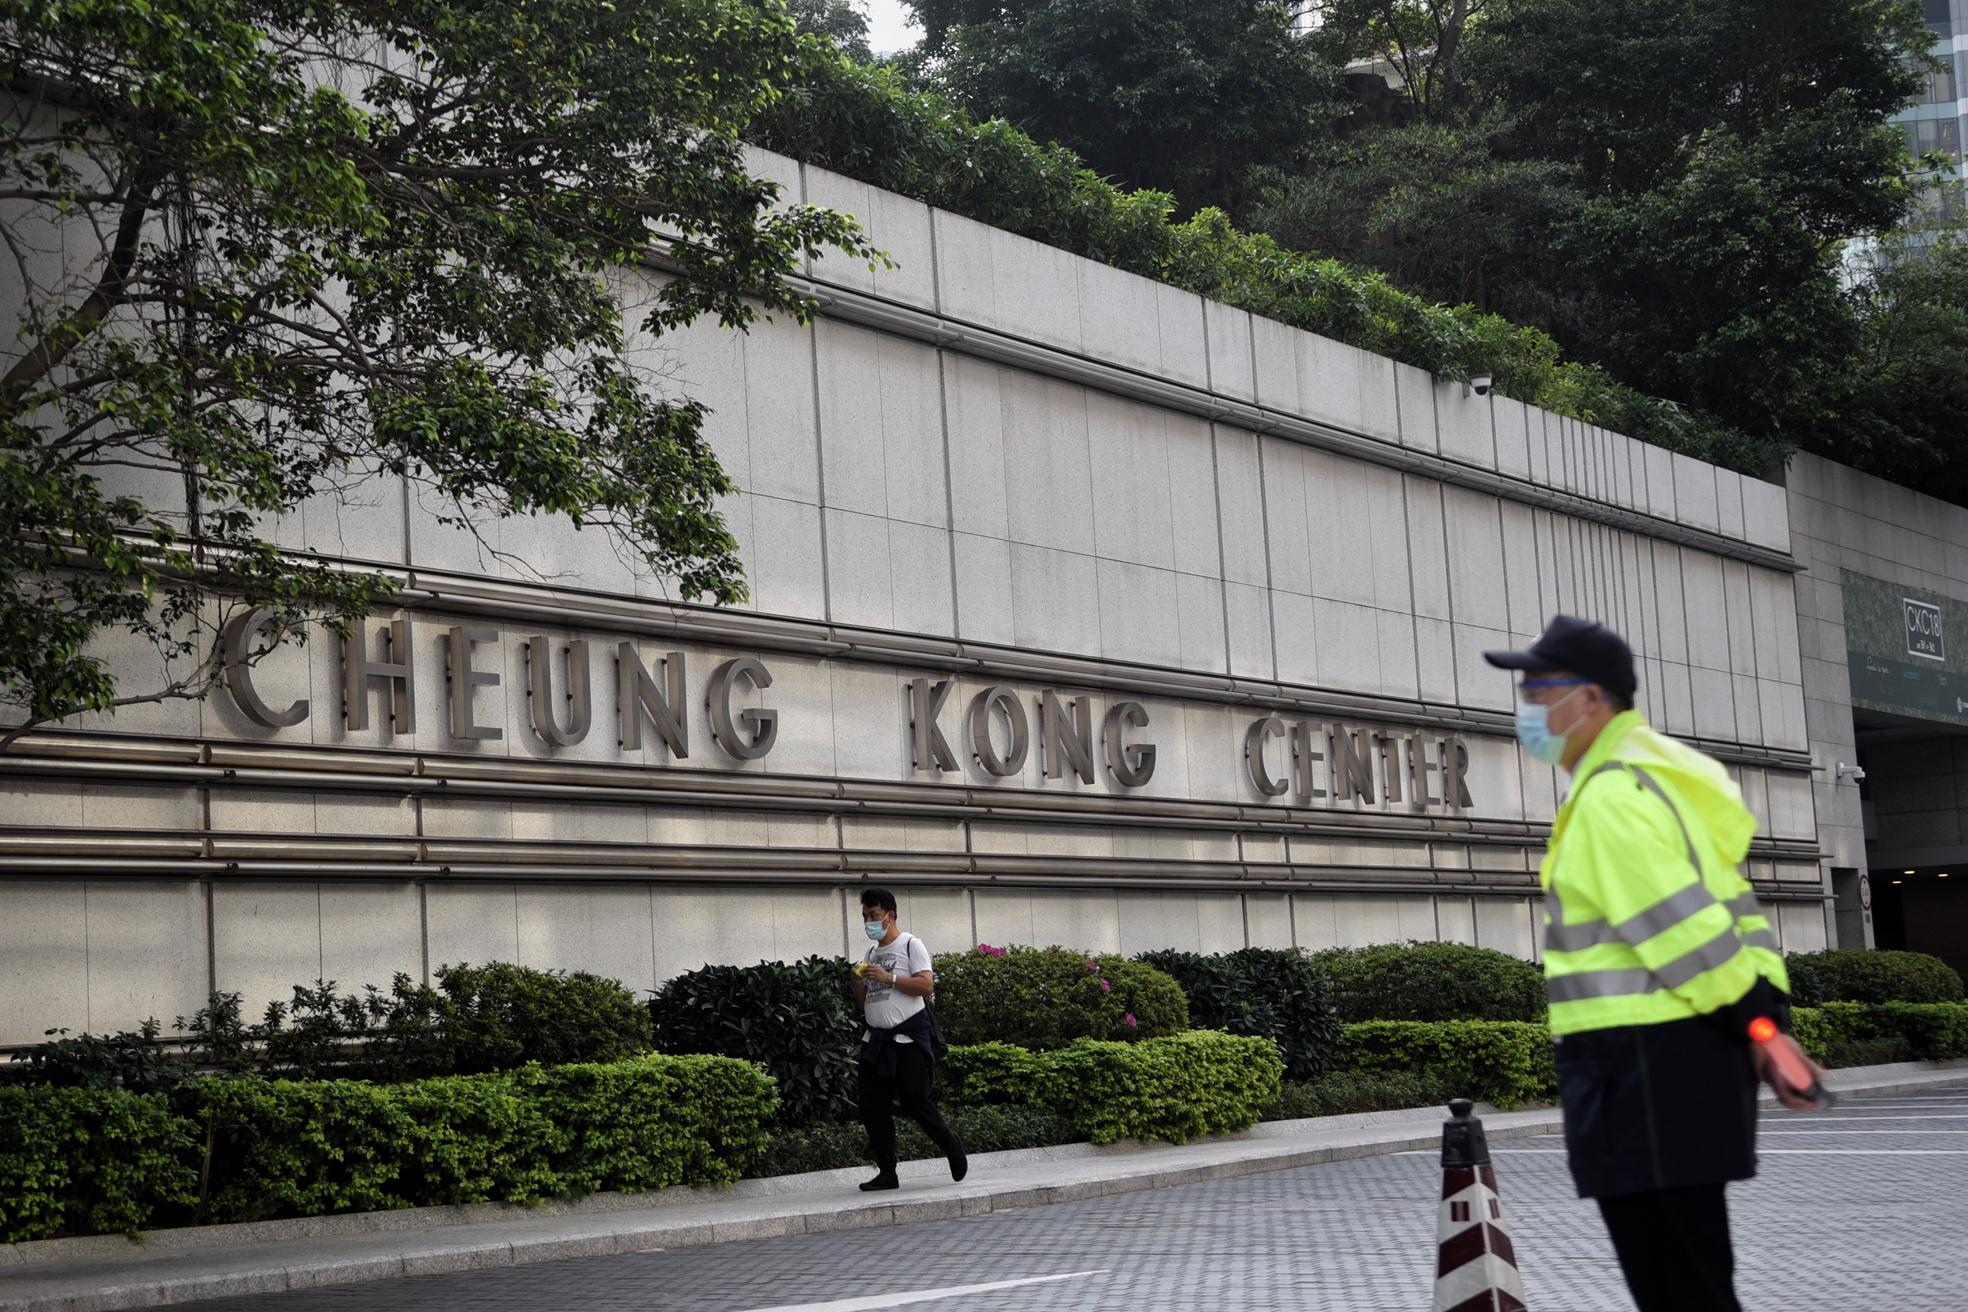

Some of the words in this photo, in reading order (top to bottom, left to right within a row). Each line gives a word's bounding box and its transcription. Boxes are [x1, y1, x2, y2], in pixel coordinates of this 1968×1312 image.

[1907, 605, 1940, 637] CKC18
[224, 605, 779, 760] CHEUNG
[912, 677, 1157, 788] KONG
[1247, 716, 1474, 808] CENTER
